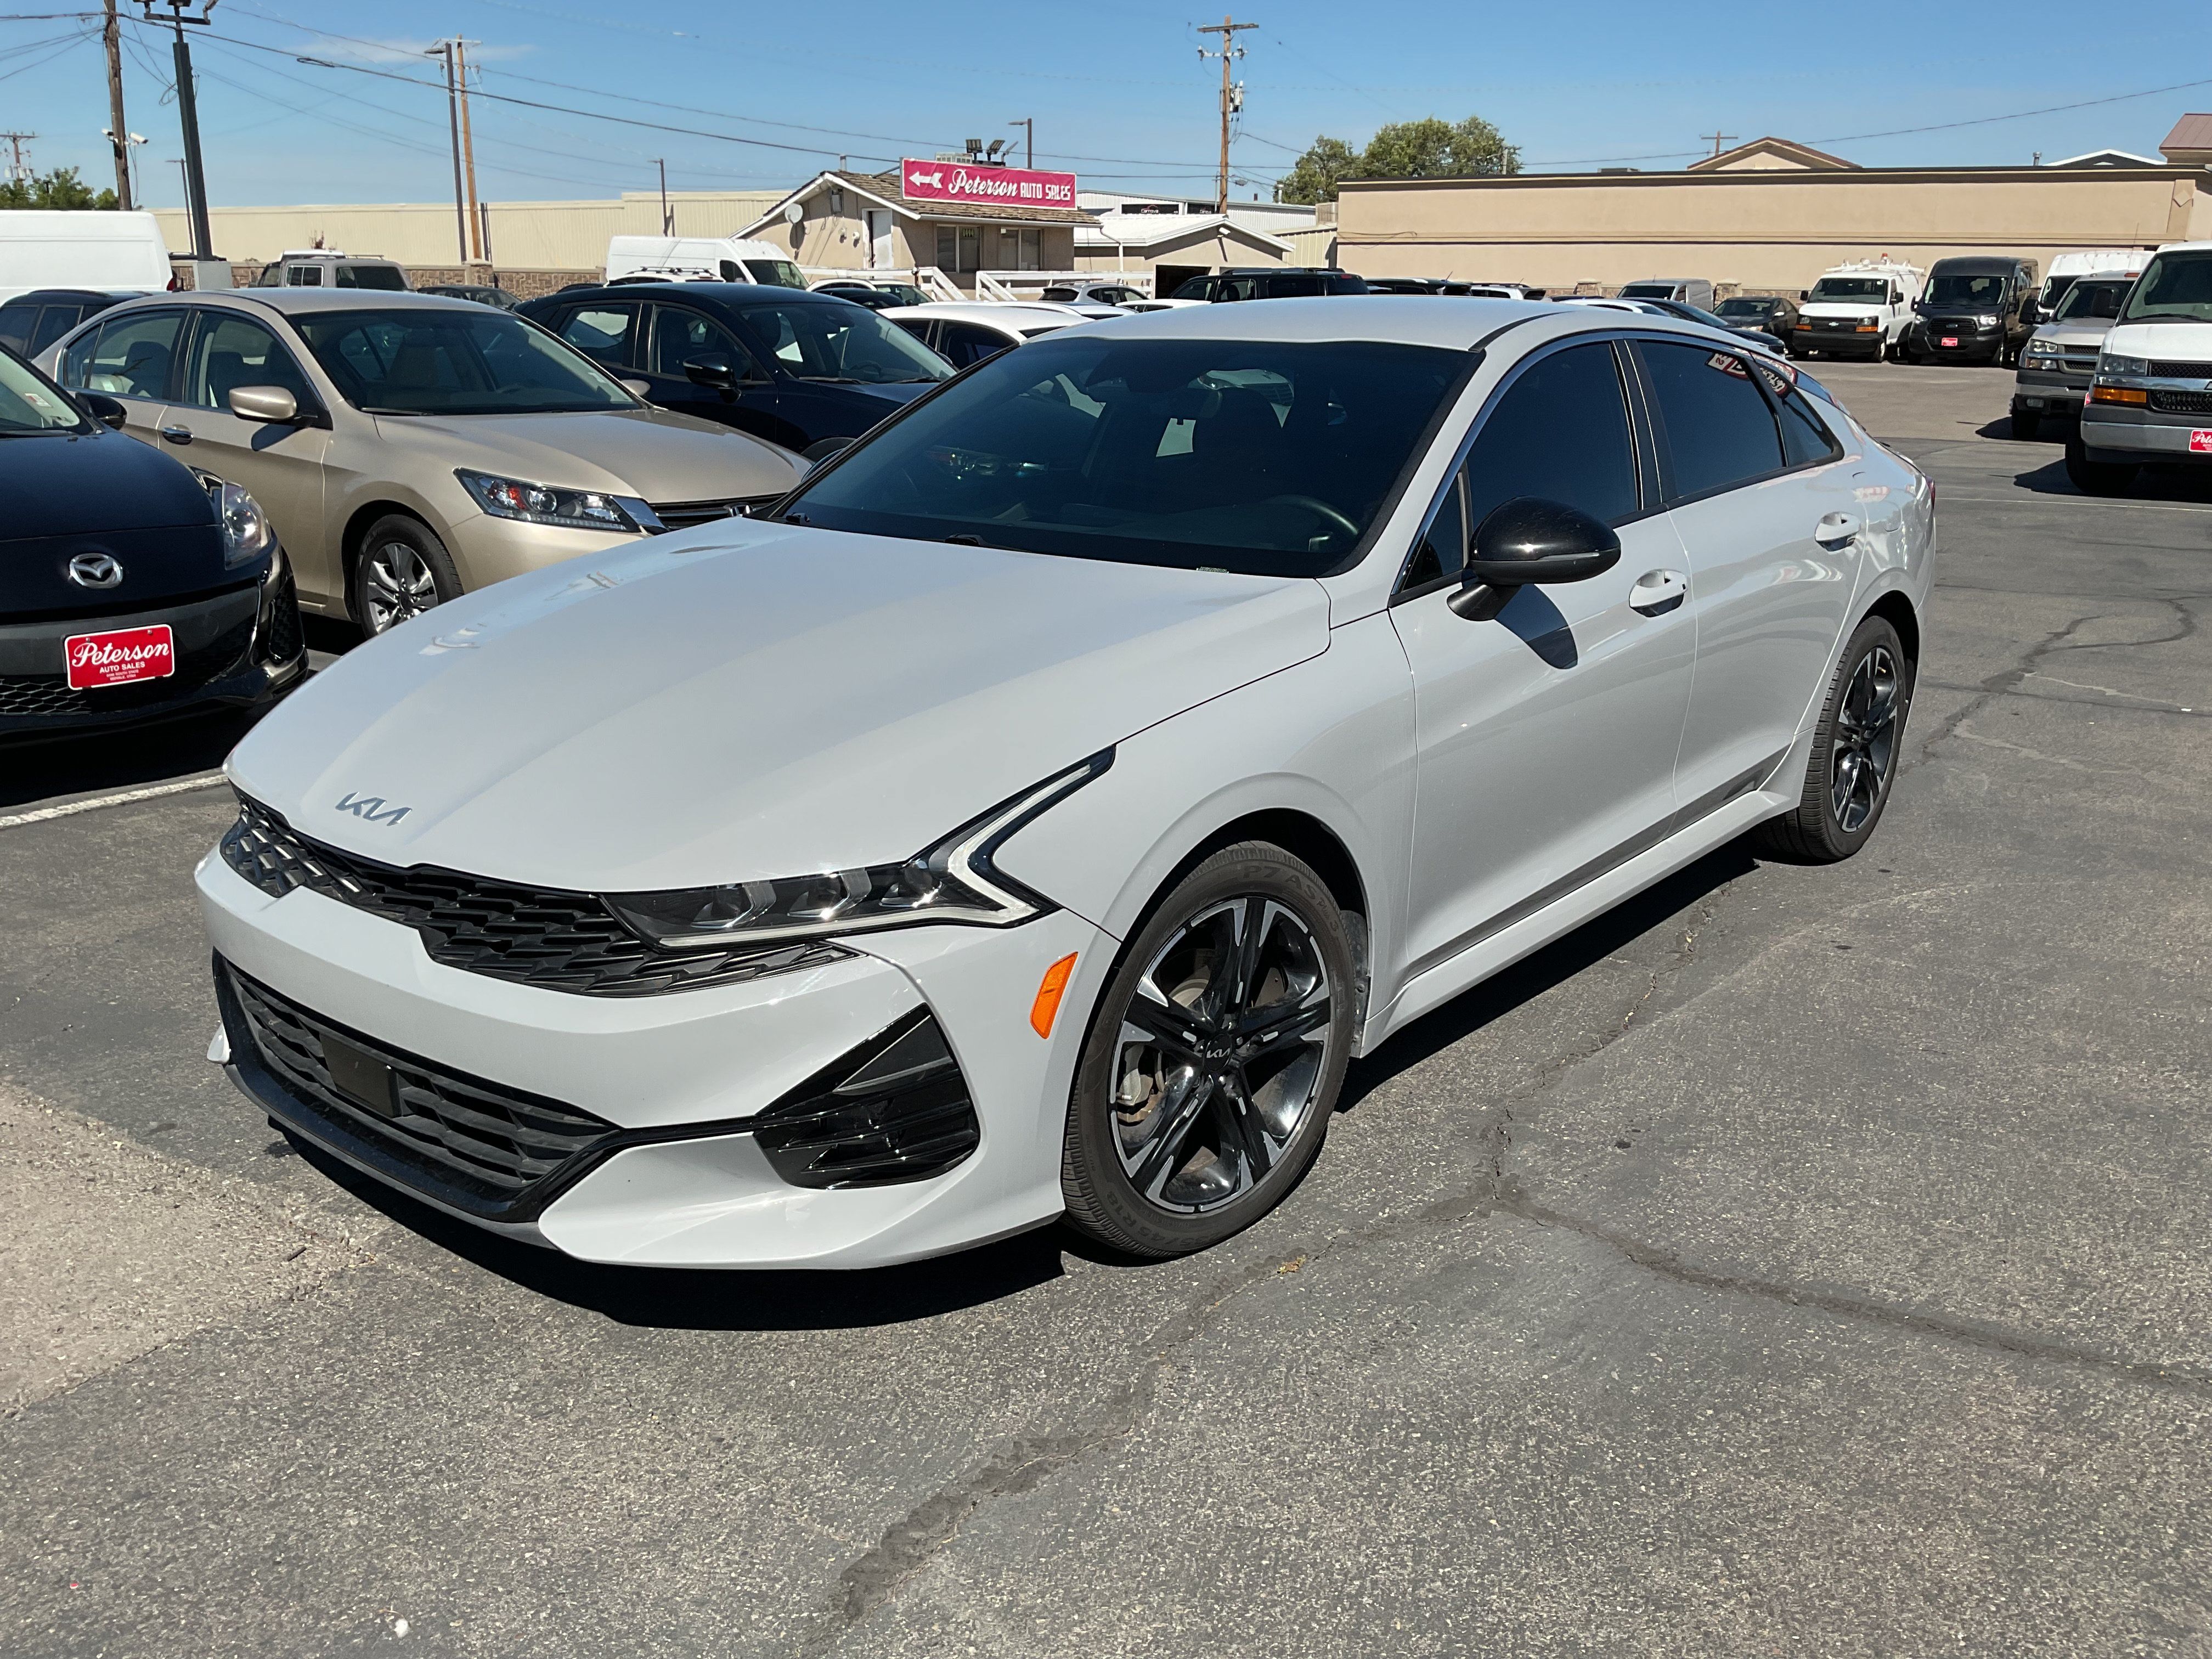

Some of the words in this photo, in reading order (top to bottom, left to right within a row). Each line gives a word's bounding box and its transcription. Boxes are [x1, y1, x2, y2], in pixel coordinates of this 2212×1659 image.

[949, 169, 1018, 197] Peterson
[1020, 182, 1042, 199] AUTO
[1045, 184, 1071, 201] SALES
[72, 642, 170, 667] Peterson
[99, 664, 120, 674] AUTO
[121, 661, 145, 670] SALES
[335, 791, 413, 826] KIA
[1206, 1048, 1231, 1058] KIA
